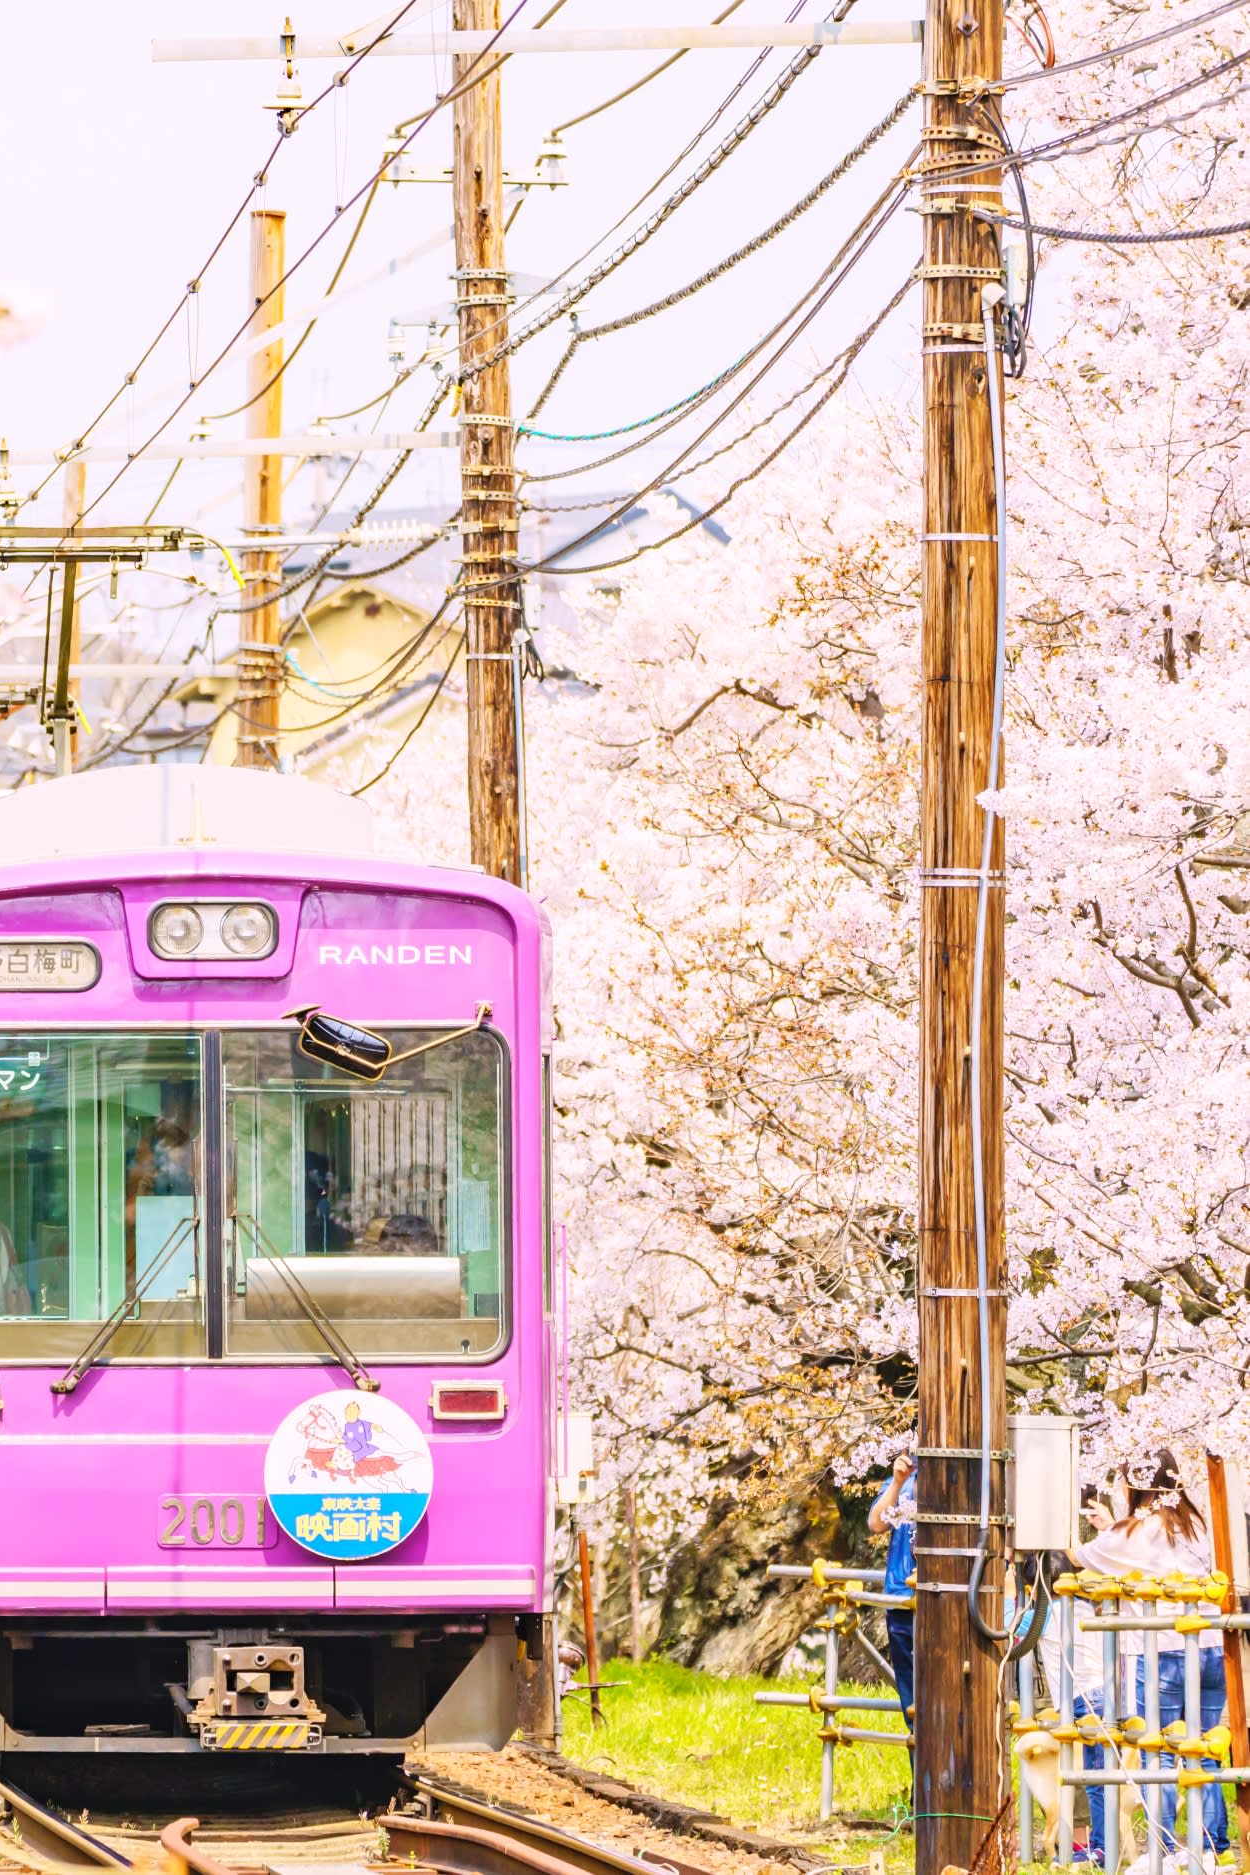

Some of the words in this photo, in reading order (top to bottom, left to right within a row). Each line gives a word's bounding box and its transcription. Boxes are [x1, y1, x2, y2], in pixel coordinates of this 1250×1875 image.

[319, 944, 472, 966] RANDEN
[161, 1497, 265, 1546] 2001
[295, 1511, 402, 1542] 映画村
